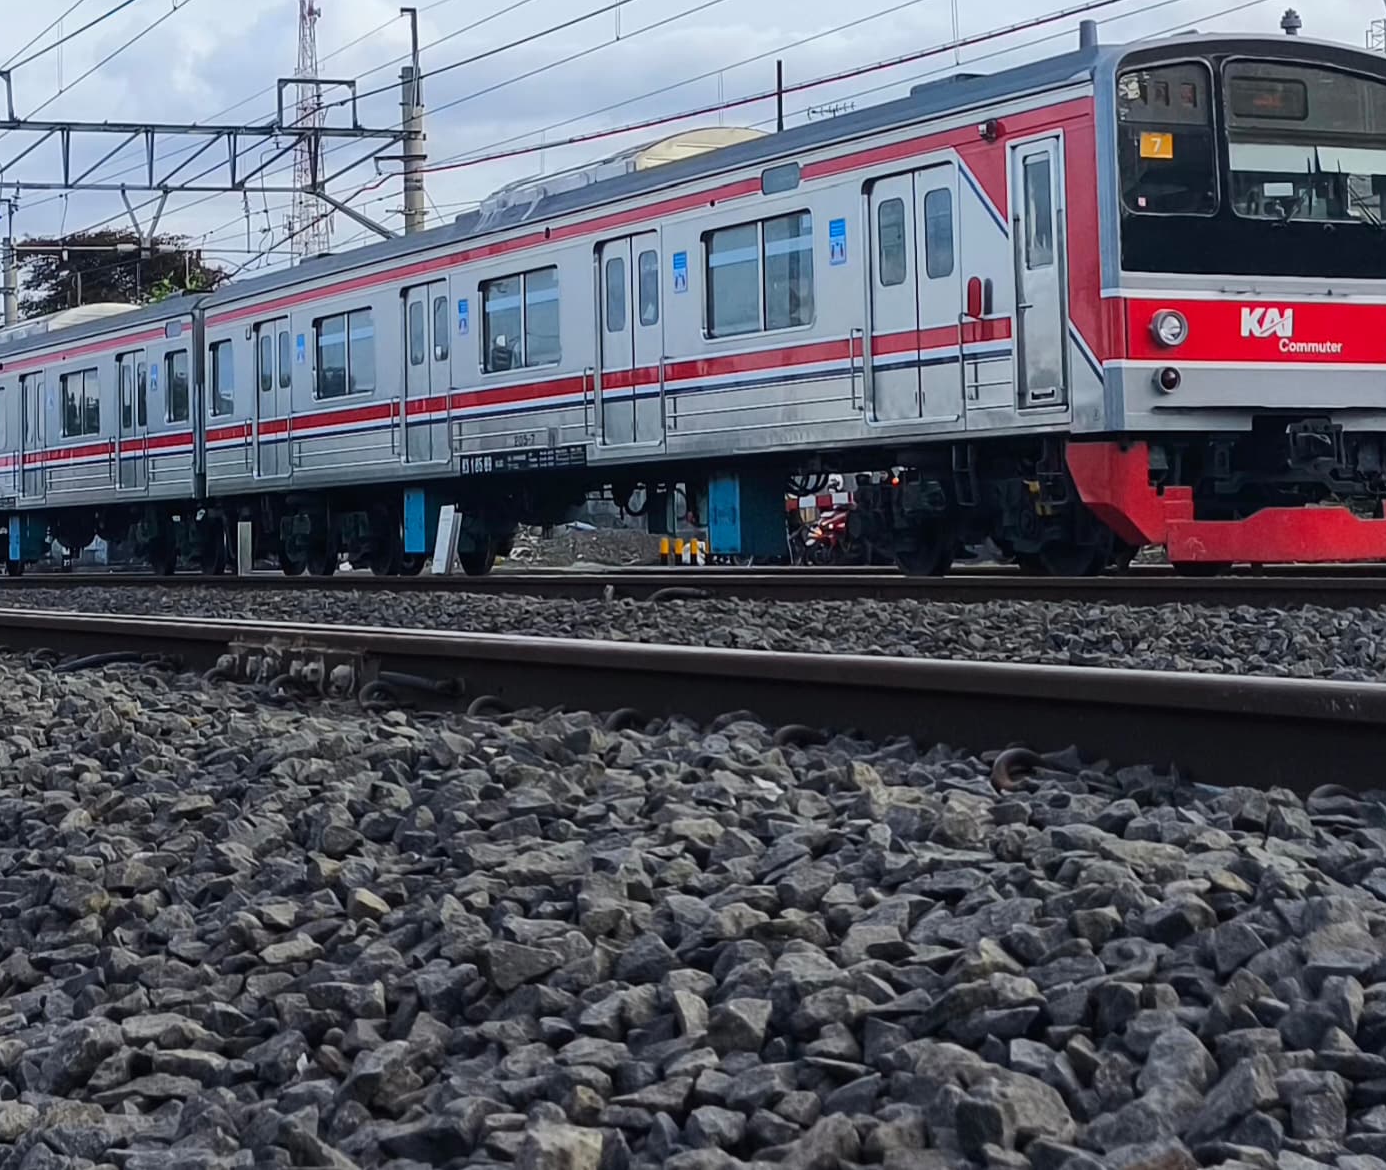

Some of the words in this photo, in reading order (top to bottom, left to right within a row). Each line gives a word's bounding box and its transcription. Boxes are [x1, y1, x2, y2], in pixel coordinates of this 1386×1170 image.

[1150, 137, 1162, 154] 7
[1240, 307, 1294, 338] KAI
[1279, 338, 1343, 353] Commuter
